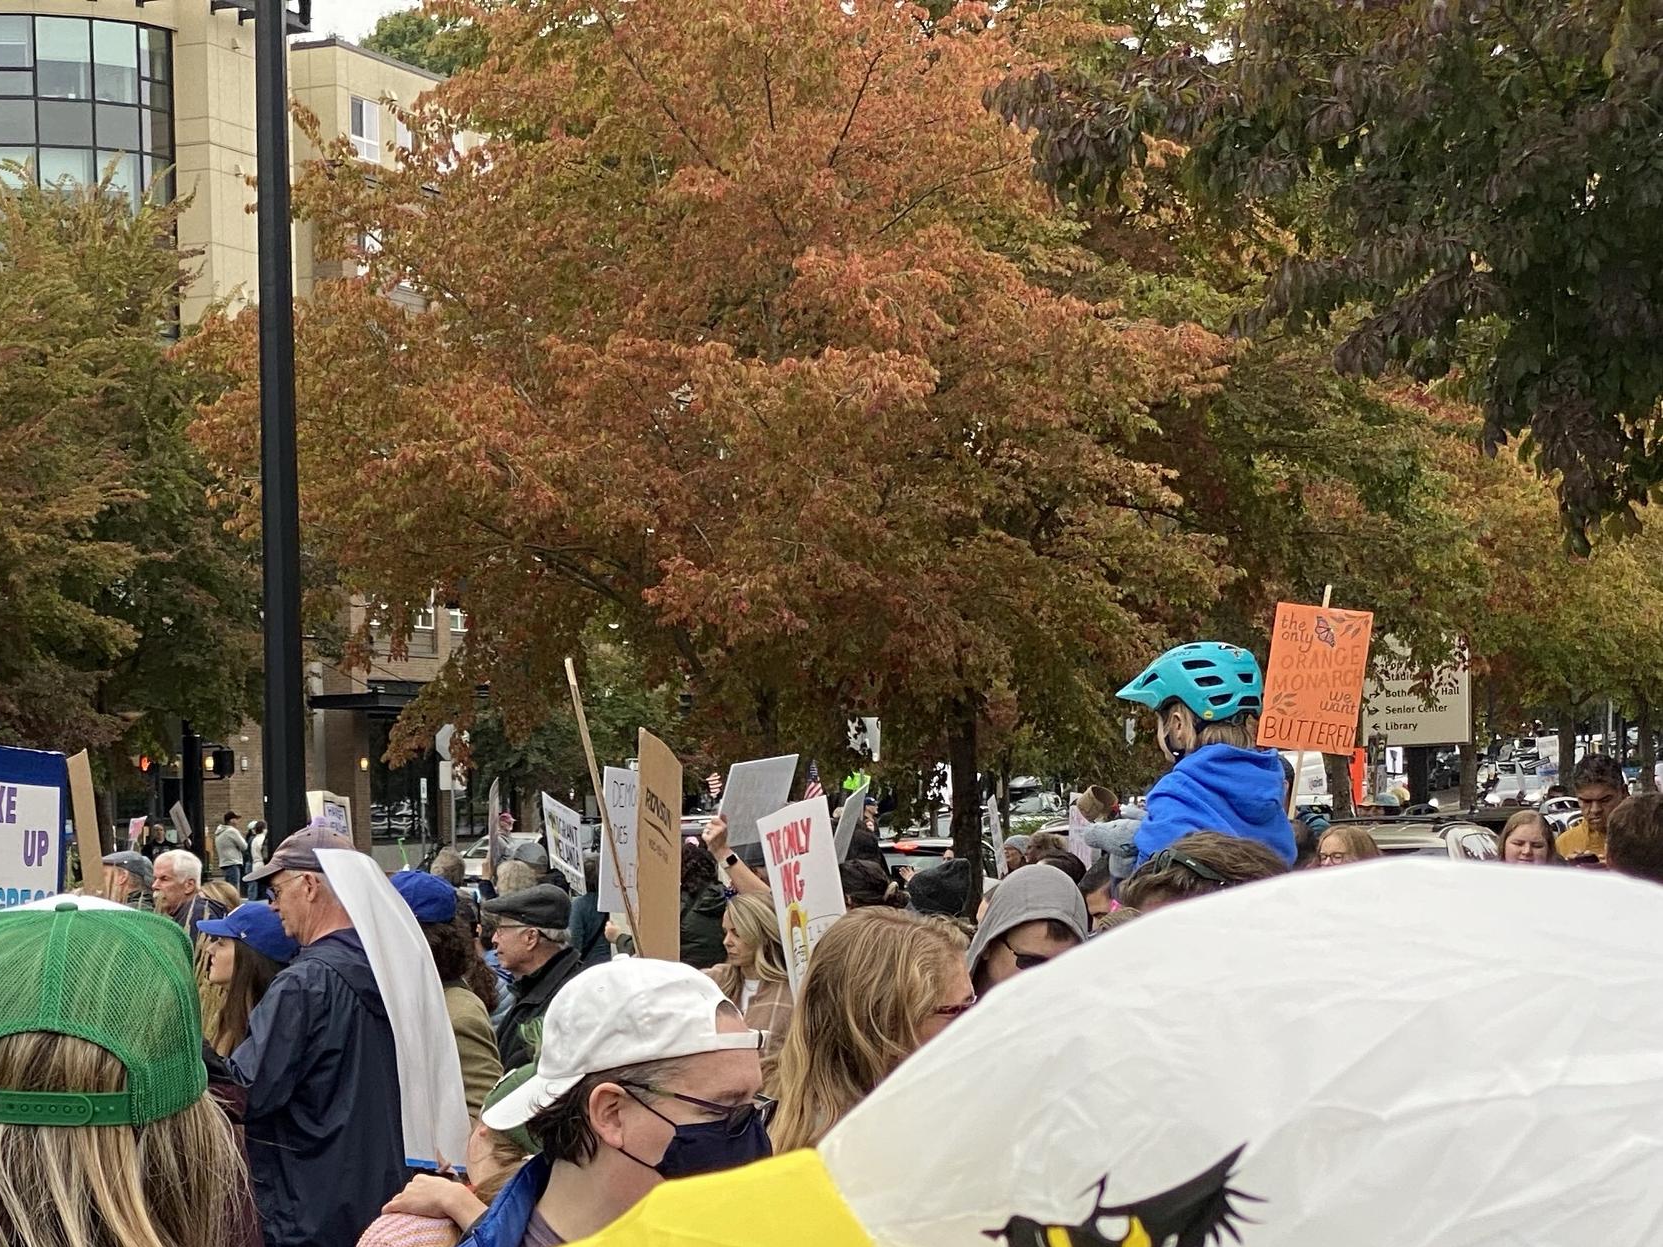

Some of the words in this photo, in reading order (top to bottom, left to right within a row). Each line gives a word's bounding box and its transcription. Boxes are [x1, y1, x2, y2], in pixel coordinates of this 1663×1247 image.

[1281, 612, 1306, 631] the
[1281, 630, 1314, 653] only
[1280, 645, 1361, 670] ORANGE
[1271, 668, 1363, 692] MONARCH
[1329, 691, 1352, 701] we
[1441, 686, 1460, 696] Hall
[1319, 700, 1357, 716] want
[1385, 705, 1416, 715] Senior
[1263, 715, 1357, 752] BUTTERFLY
[1385, 722, 1418, 731] Library
[22, 829, 50, 867] UP
[782, 817, 812, 859] ONLY
